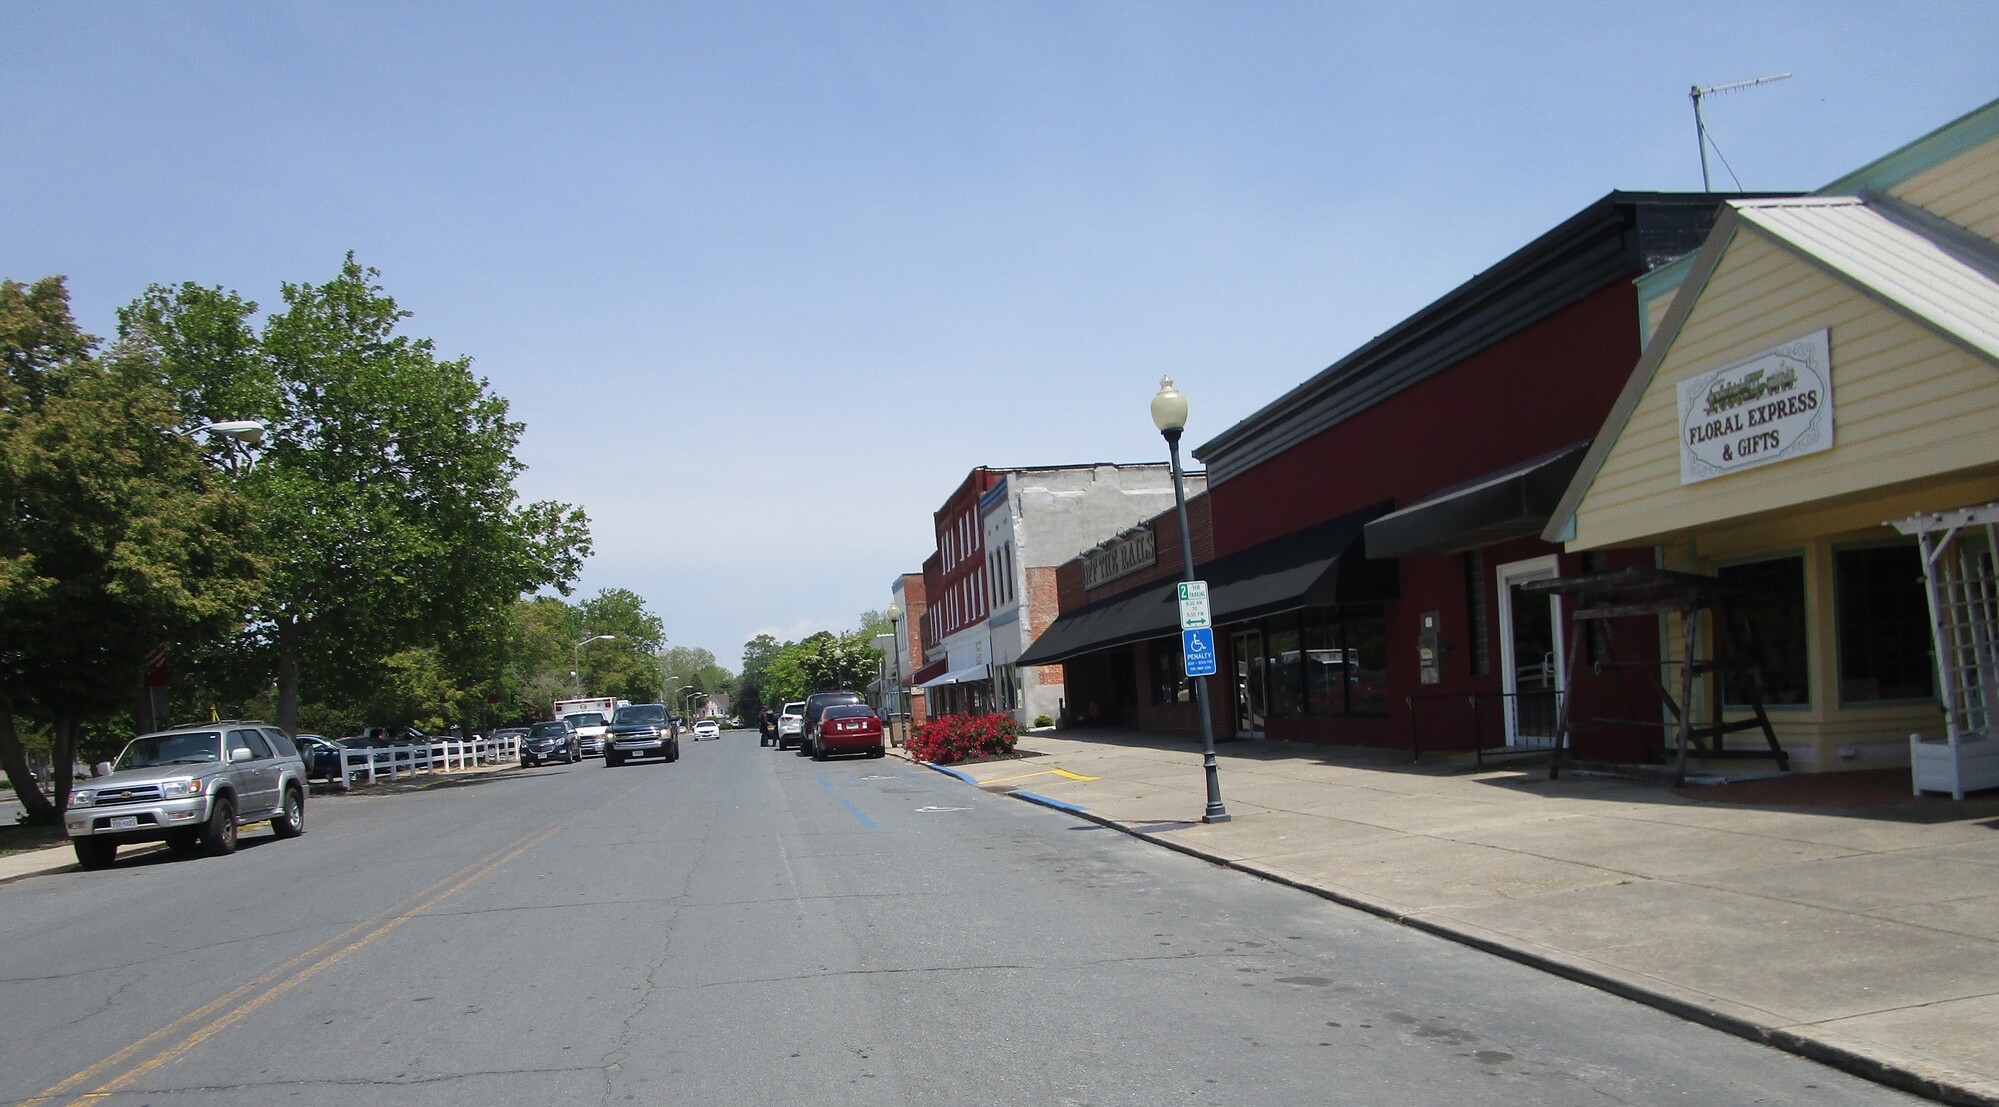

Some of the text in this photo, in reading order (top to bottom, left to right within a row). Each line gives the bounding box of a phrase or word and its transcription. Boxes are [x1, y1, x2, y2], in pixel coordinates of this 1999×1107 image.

[1689, 390, 1818, 445] FLORAL EXPRESS
[1722, 429, 1780, 461] & GIFTS
[1099, 549, 1119, 578] THE
[1121, 532, 1154, 570] RAILS
[1180, 585, 1187, 598] 2
[1187, 652, 1211, 660] PENALTY
